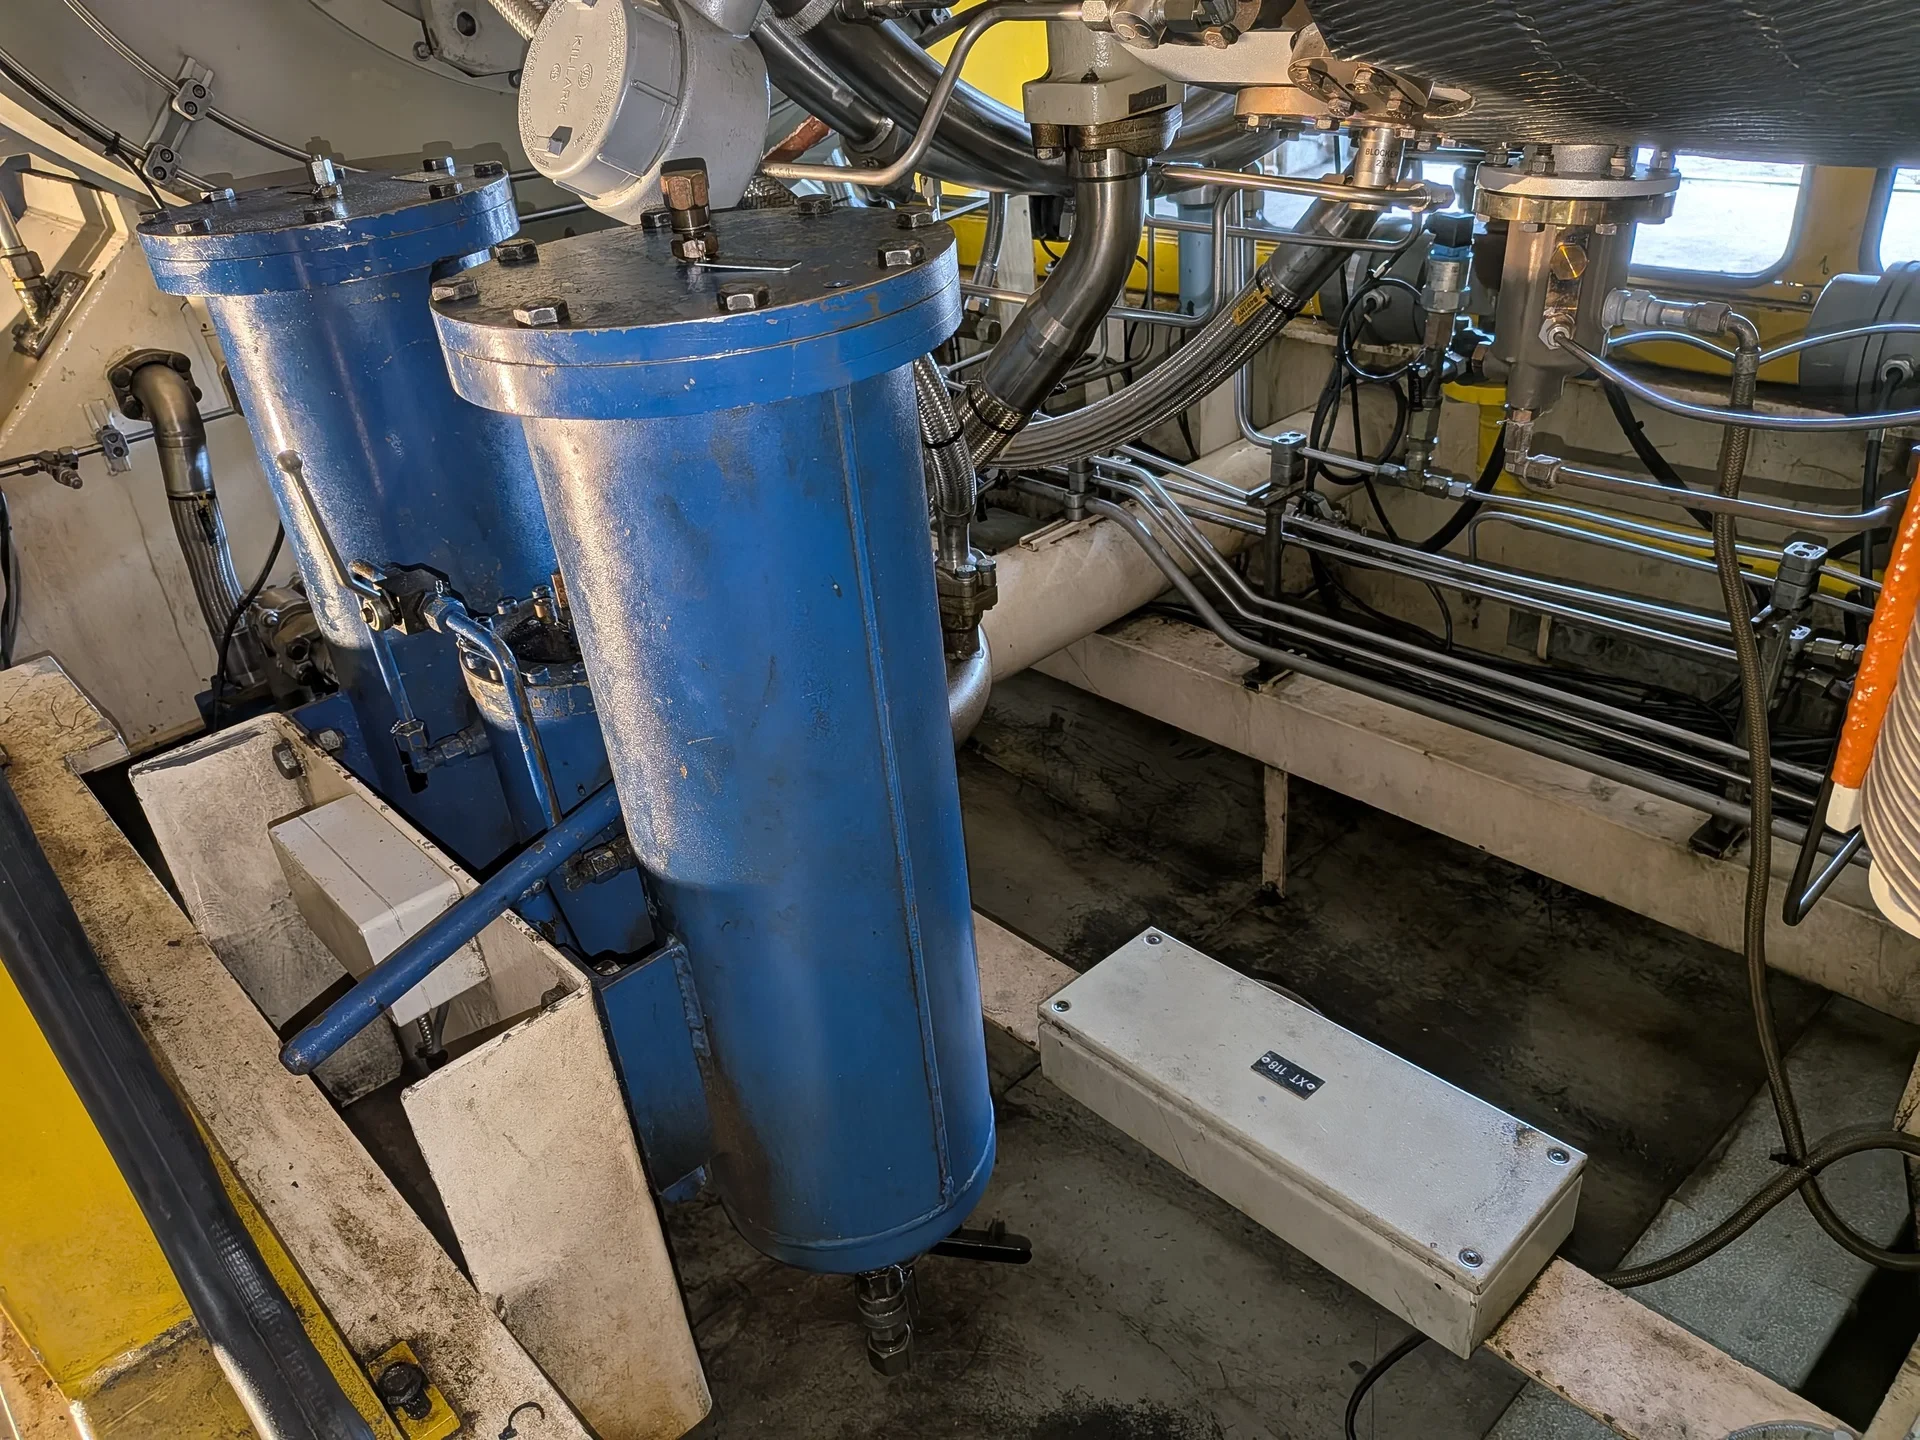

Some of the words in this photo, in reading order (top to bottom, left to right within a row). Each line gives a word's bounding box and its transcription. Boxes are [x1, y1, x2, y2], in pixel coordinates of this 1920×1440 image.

[557, 35, 583, 114] KILLARK
[1365, 148, 1399, 158] BLOCKER
[1268, 1061, 1287, 1075] 118
[1289, 1074, 1308, 1087] XT
